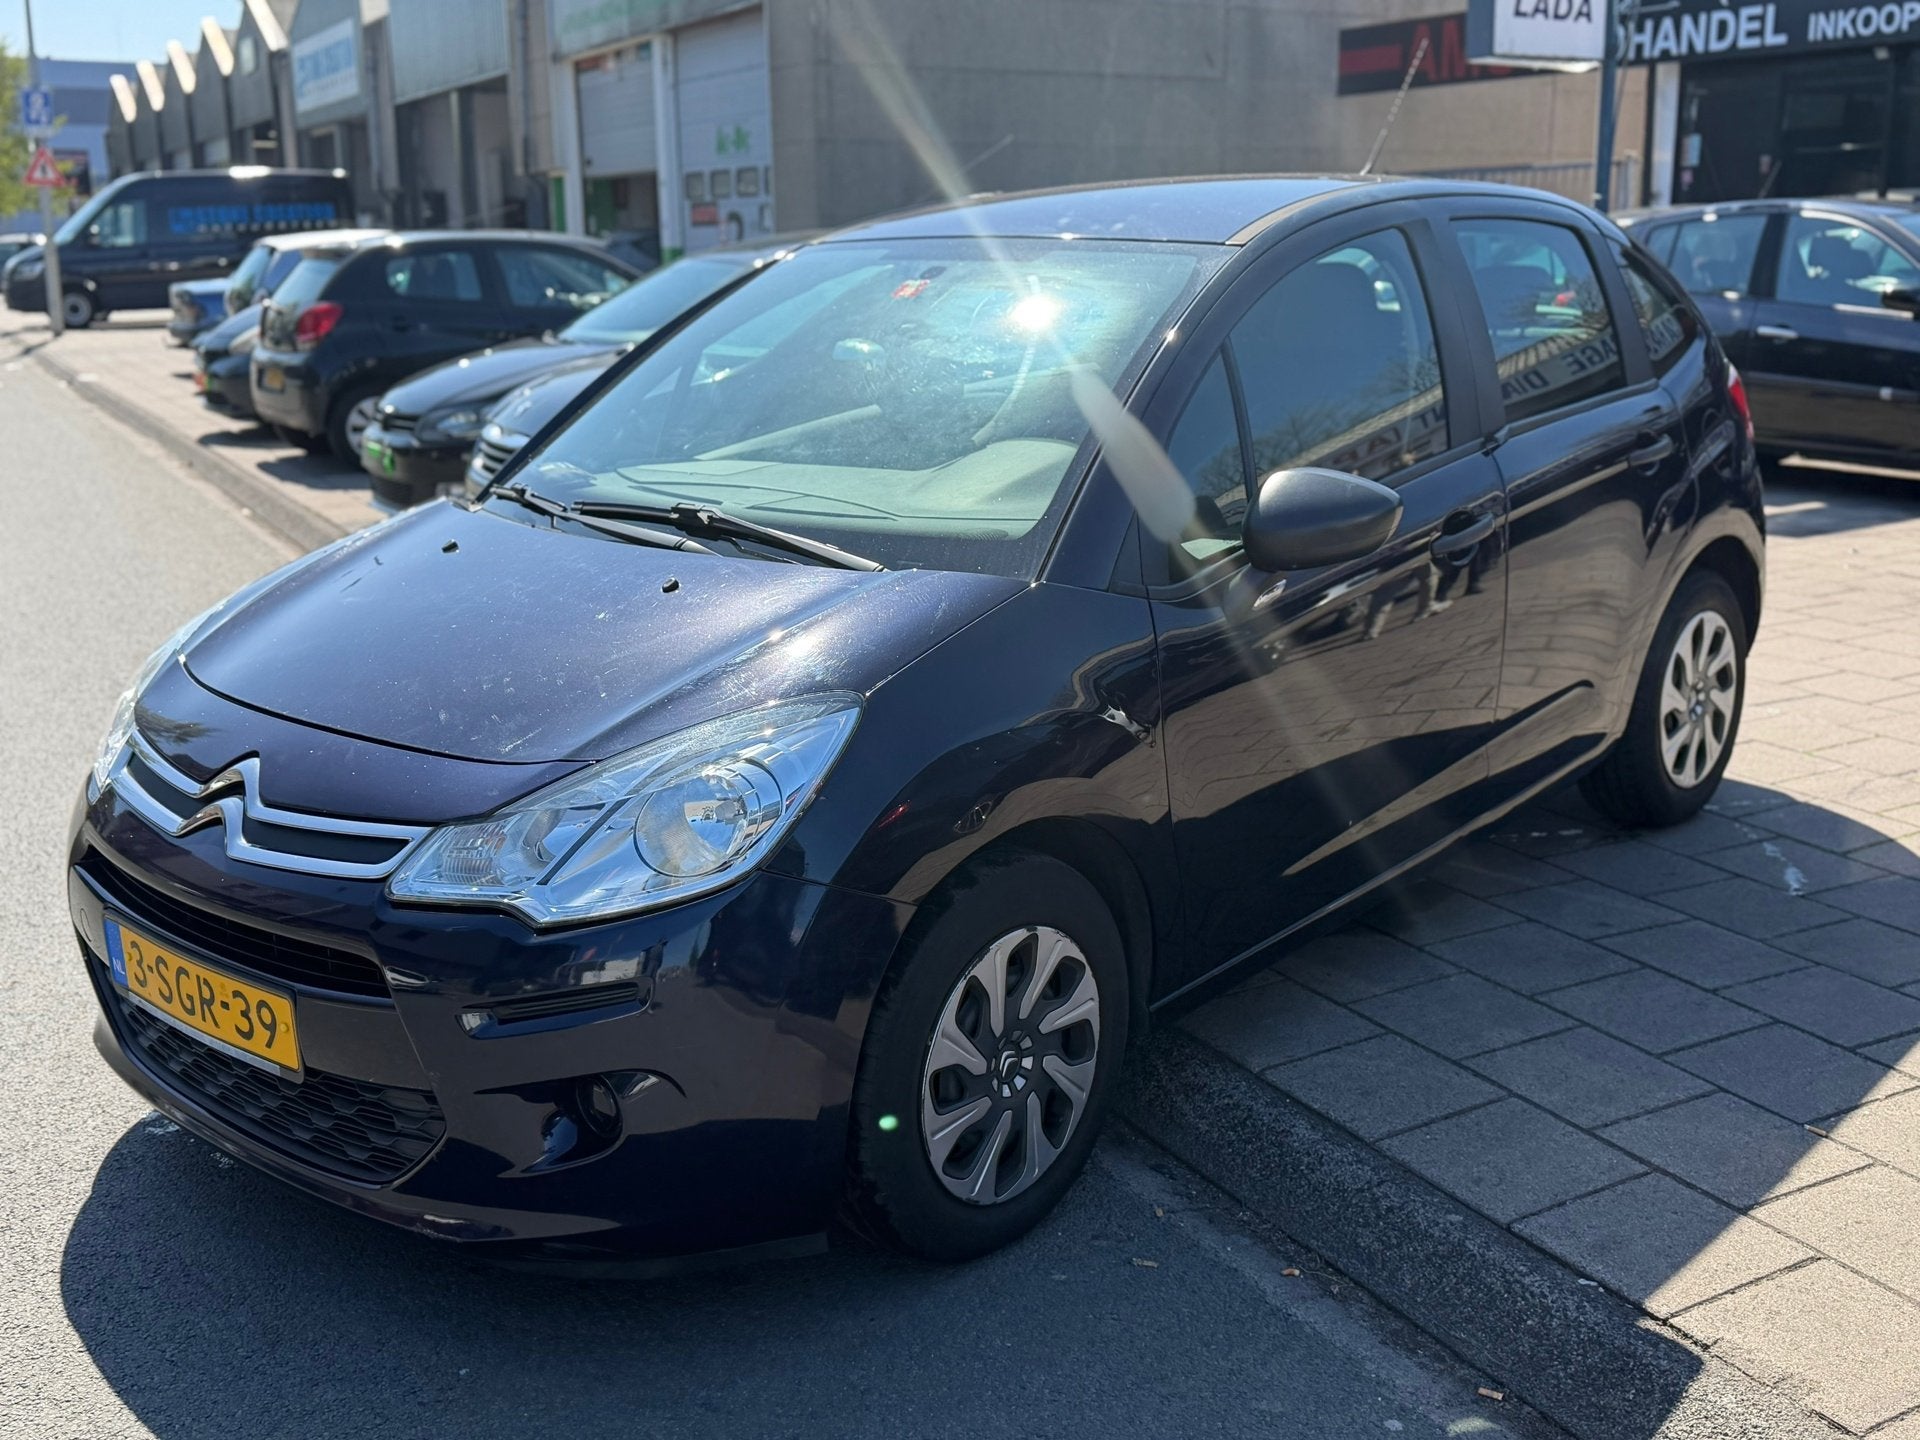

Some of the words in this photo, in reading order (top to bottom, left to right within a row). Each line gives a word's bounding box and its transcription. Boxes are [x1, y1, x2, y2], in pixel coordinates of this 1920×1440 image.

[1514, 0, 1592, 23] LADA
[1808, 2, 1920, 42] INKOOP
[112, 956, 126, 976] NL
[129, 940, 278, 1049] 3-SGR-39
